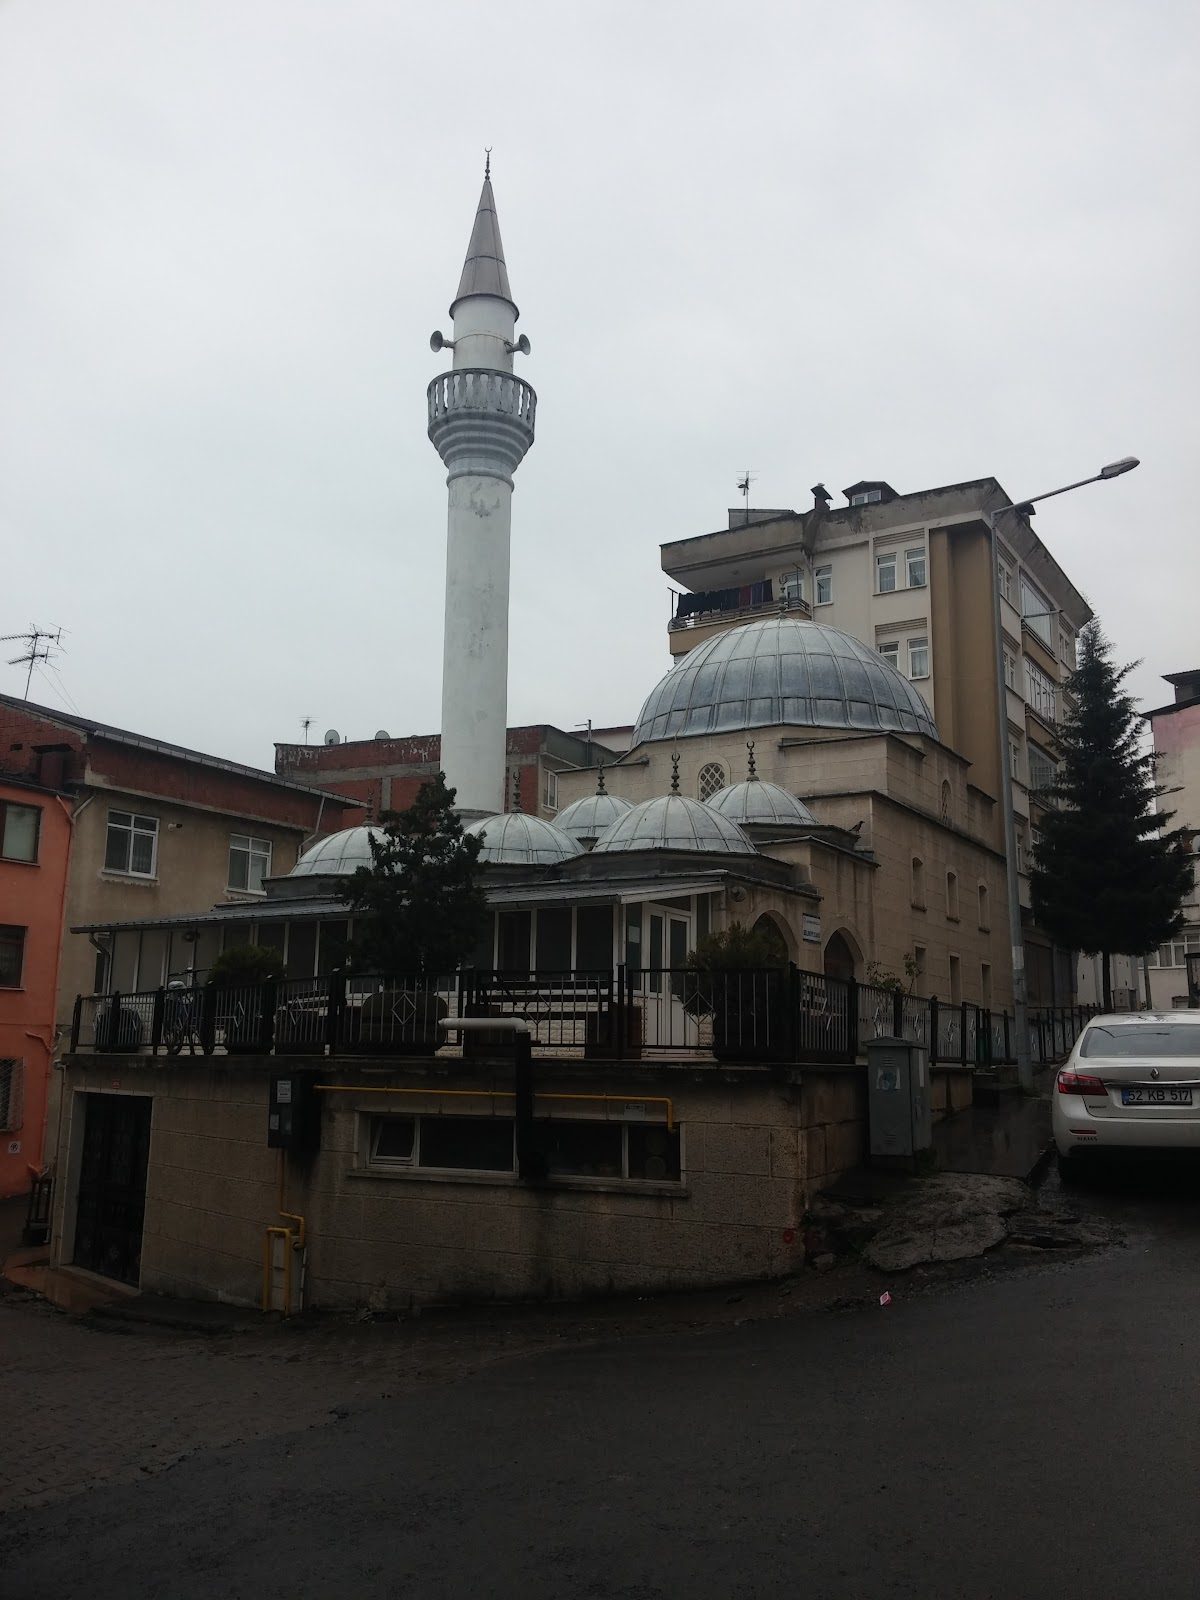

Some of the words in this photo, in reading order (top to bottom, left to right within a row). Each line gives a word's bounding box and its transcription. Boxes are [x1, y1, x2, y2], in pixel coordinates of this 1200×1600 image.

[1129, 1090, 1143, 1101] 52
[1148, 1090, 1165, 1101] KB
[1170, 1090, 1189, 1101] 517
